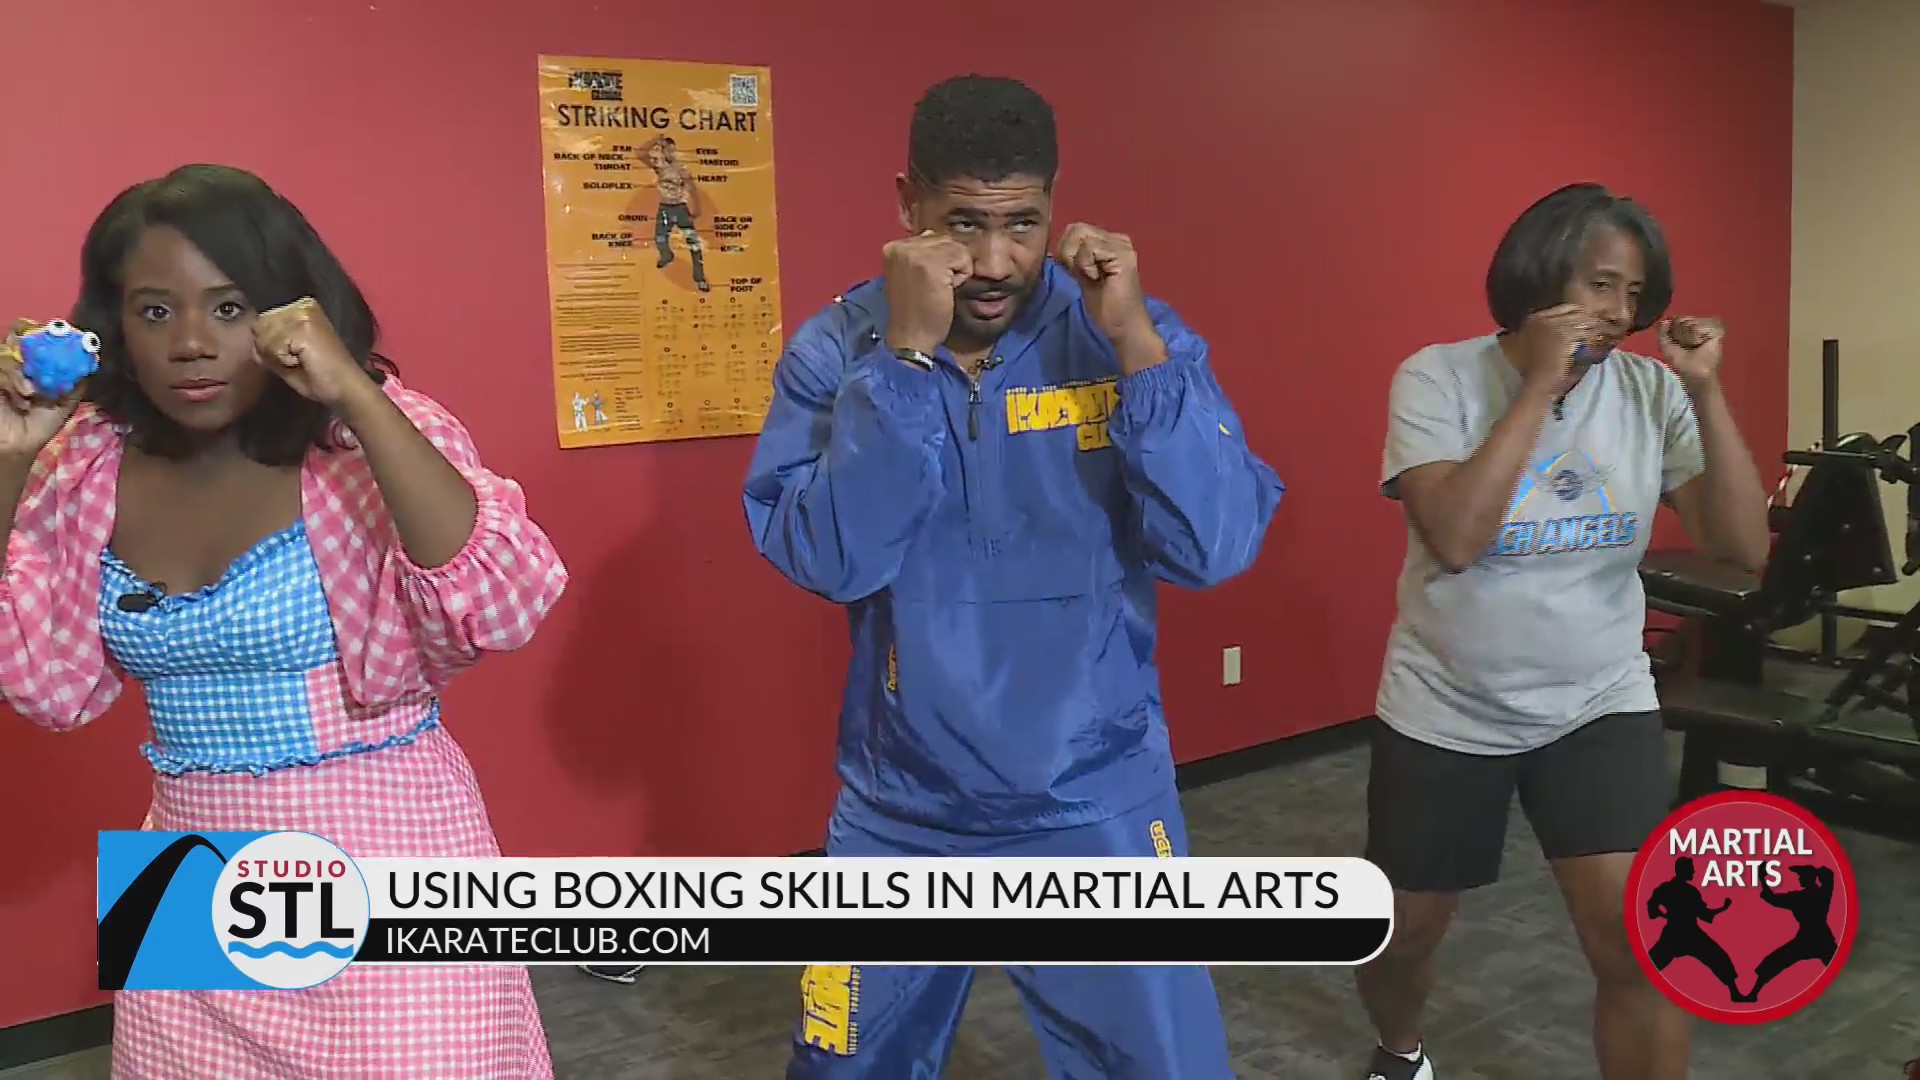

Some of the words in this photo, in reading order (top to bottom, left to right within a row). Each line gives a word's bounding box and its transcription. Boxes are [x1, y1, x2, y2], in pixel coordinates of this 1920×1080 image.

[557, 103, 671, 129] STRIKING
[679, 107, 758, 132] CHART
[599, 153, 624, 161] NECK
[594, 163, 632, 171] THROAT
[1538, 511, 1638, 553] ANGELS
